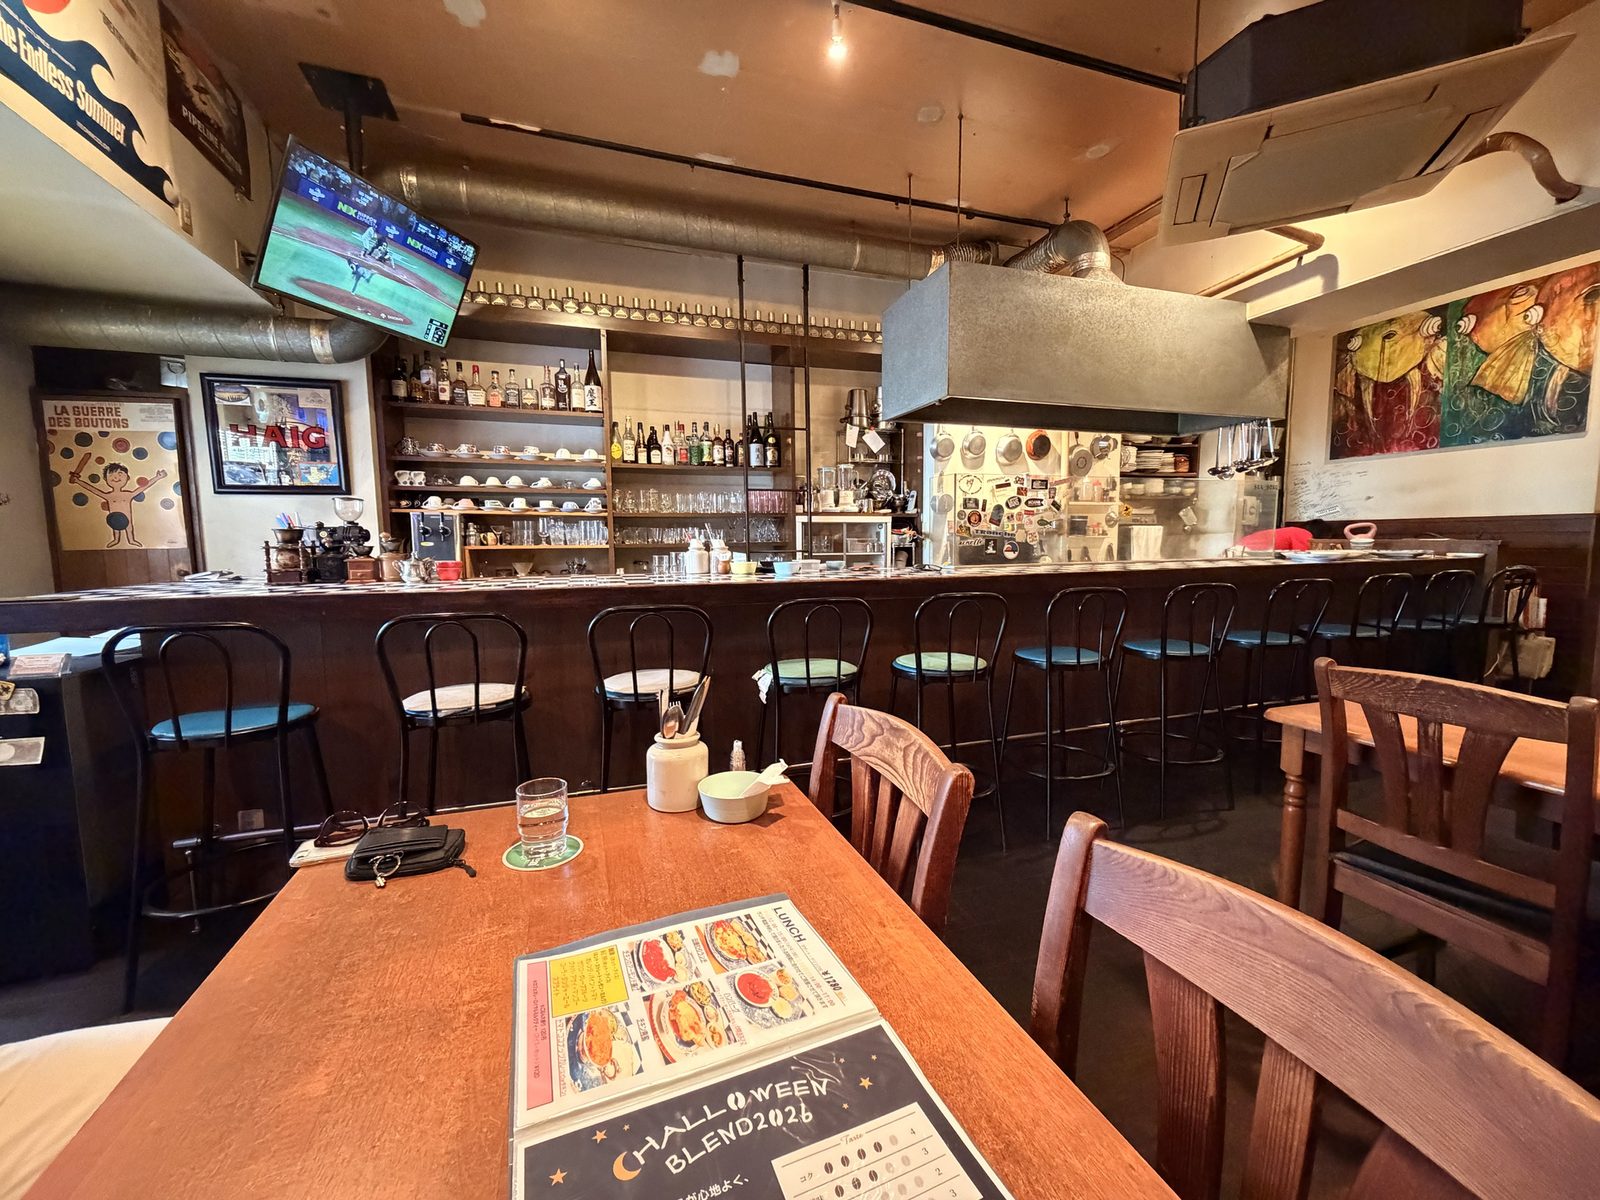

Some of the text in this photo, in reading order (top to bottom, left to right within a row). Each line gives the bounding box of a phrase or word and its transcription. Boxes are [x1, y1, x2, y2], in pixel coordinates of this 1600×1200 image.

[0, 10, 18, 54] he
[17, 27, 74, 101] Endless
[76, 80, 127, 145] Summer
[54, 405, 121, 417] LA GUERRE
[48, 416, 129, 428] DES BOUTONS
[229, 424, 326, 449] HAIG
[773, 906, 807, 943] LUNCH
[822, 970, 842, 991] ¥1280
[632, 1079, 829, 1165] HALLOWEEN
[910, 1128, 917, 1136] 4
[839, 1132, 864, 1146] Taste
[921, 1147, 929, 1156] 3
[800, 1172, 813, 1183] コク
[934, 1167, 943, 1177] 2
[678, 1173, 750, 1200] が心地よく、
[949, 1188, 958, 1198] 3
